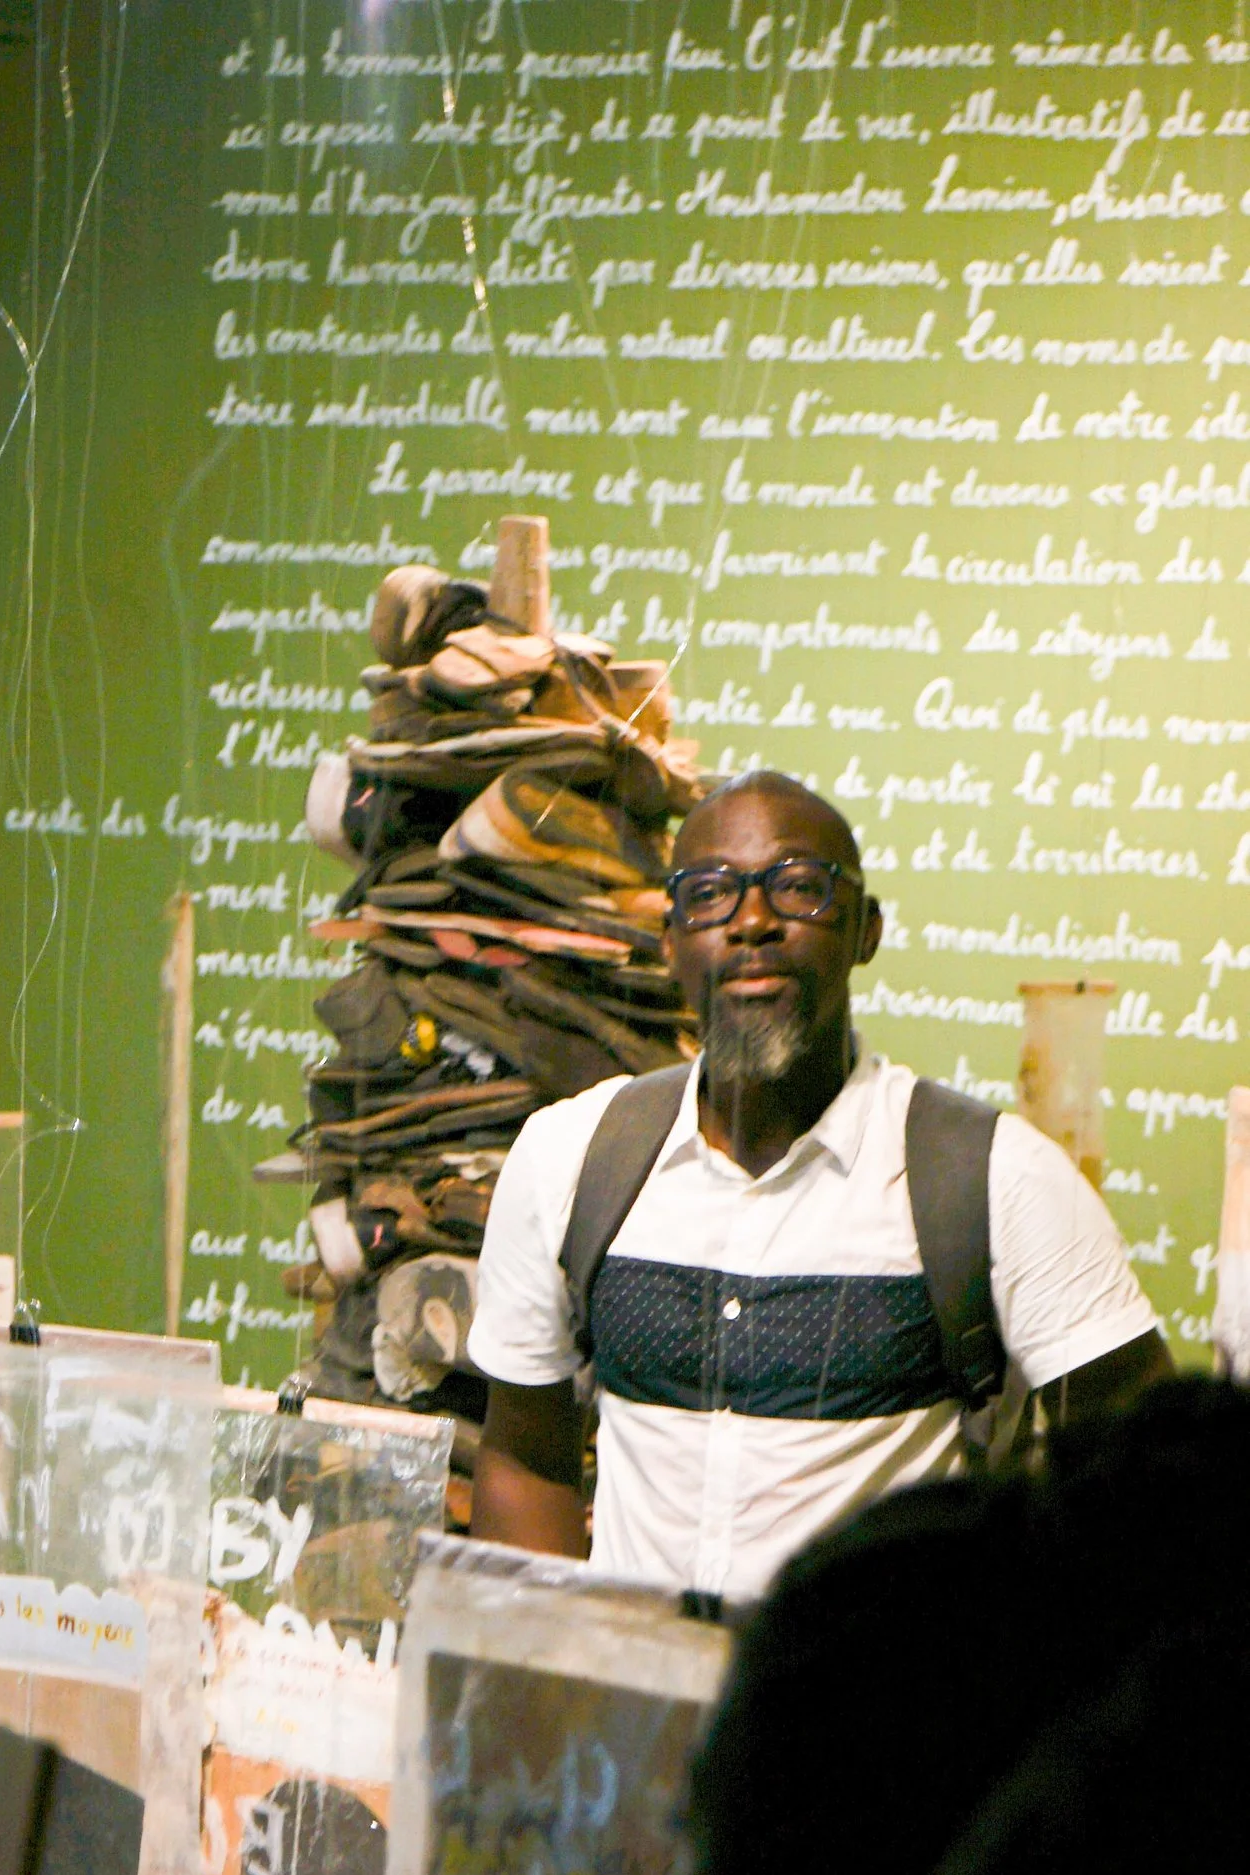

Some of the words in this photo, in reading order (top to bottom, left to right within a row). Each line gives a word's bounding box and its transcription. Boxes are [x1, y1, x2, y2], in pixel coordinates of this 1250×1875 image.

[1104, 32, 1147, 67] de
[1152, 27, 1193, 64] la
[591, 98, 632, 142] de
[800, 100, 848, 142] de
[1156, 88, 1208, 140] de
[588, 259, 655, 310] par
[1142, 322, 1193, 365] de
[1013, 391, 1067, 444] de
[1072, 388, 1173, 440] notre
[593, 464, 643, 507] est
[646, 476, 704, 528] que
[721, 454, 753, 505] le
[756, 463, 879, 508] monde
[893, 464, 946, 507] est
[900, 531, 943, 581] la
[1154, 536, 1226, 584] des
[962, 608, 1022, 652] des
[1184, 614, 1233, 661] du
[770, 682, 819, 728] de
[1012, 689, 1054, 735] de
[1058, 697, 1151, 756] plus
[833, 755, 873, 799] de
[1130, 762, 1184, 811] les
[950, 828, 994, 873] de
[1175, 993, 1239, 1043] des
